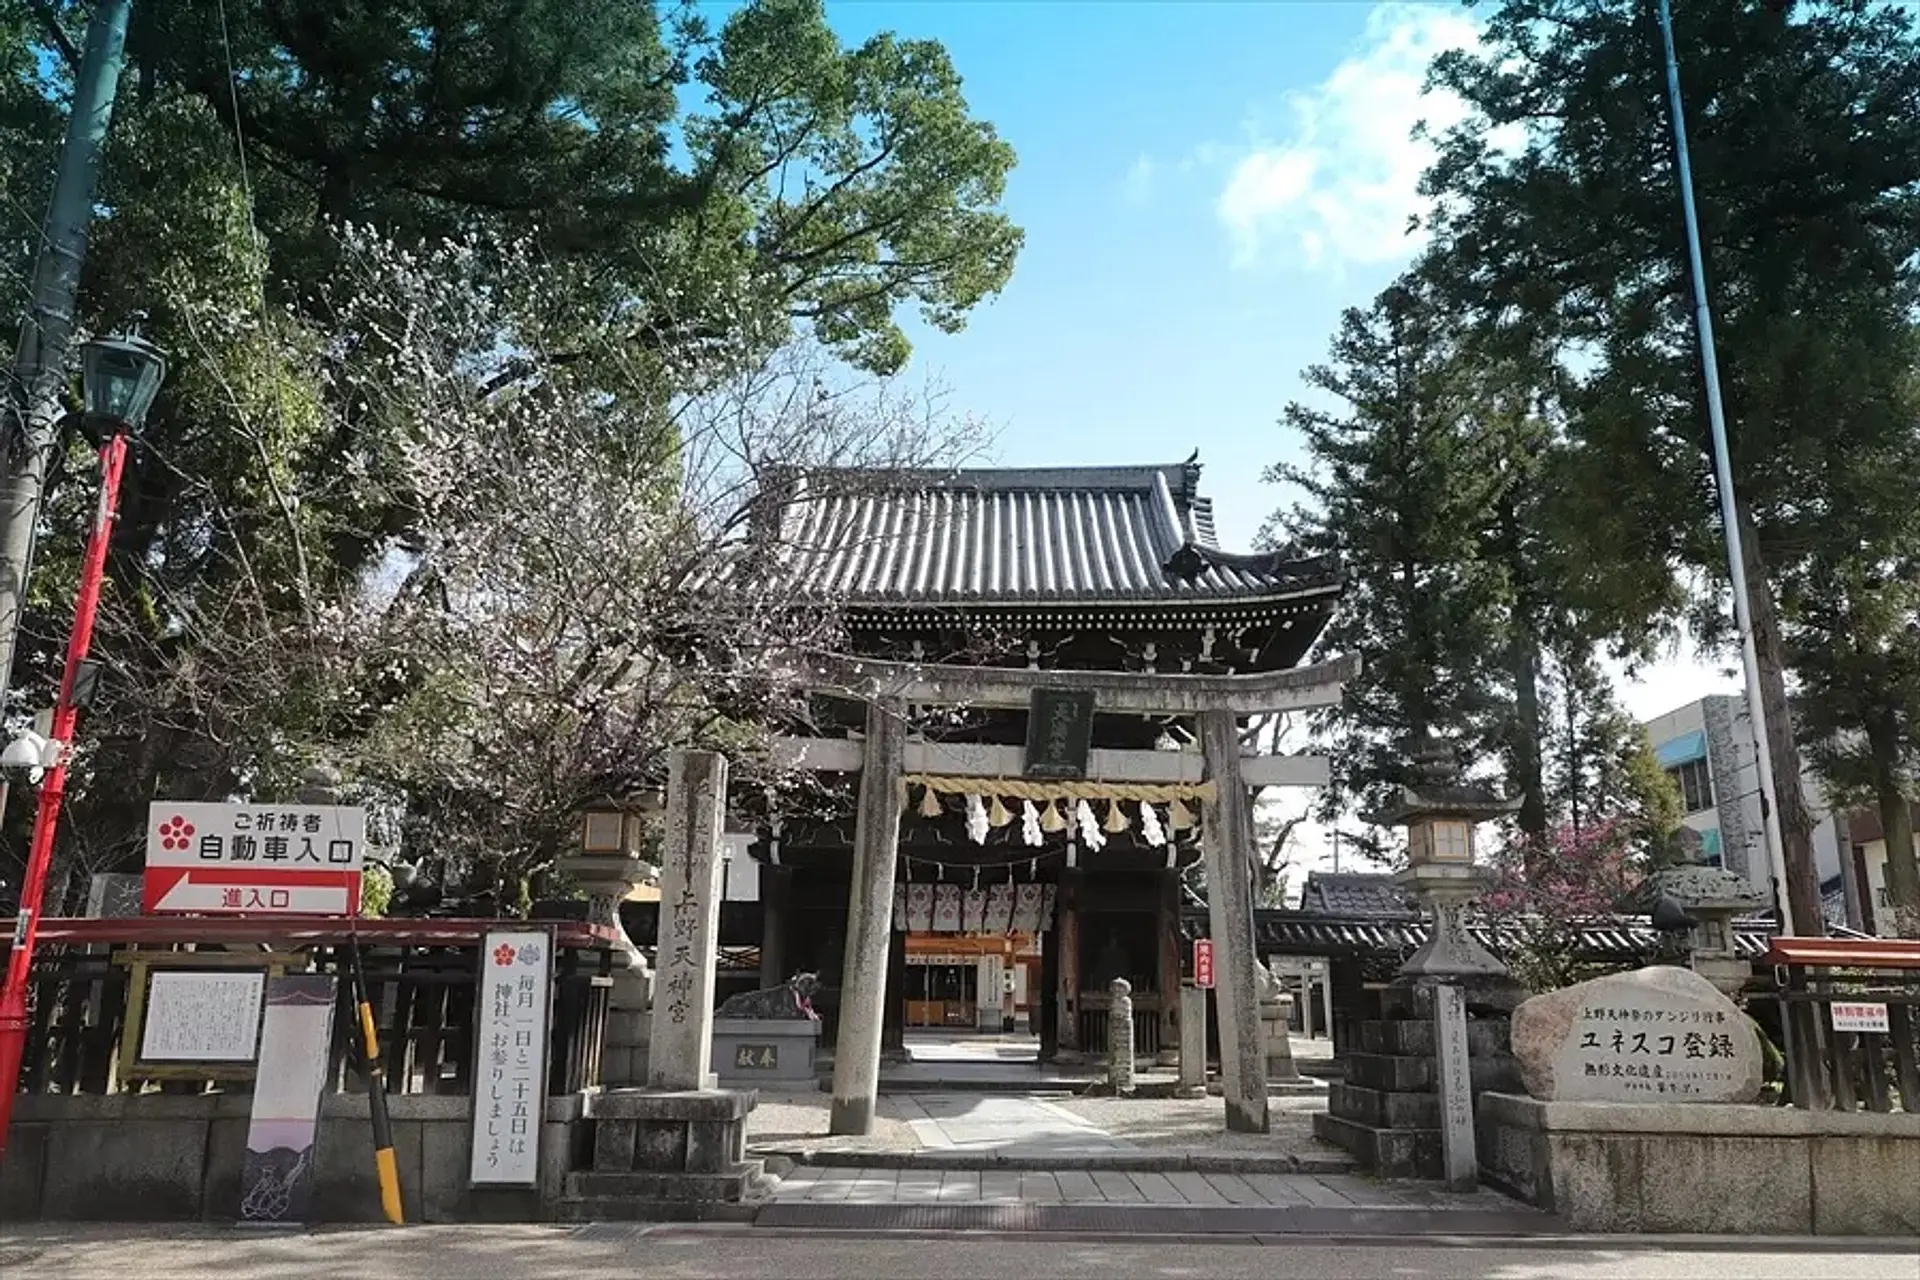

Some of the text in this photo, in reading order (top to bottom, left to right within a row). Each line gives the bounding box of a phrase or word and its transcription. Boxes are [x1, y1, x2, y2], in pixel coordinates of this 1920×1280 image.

[234, 812, 322, 833] ご祈祷者
[199, 834, 353, 863] 自動車入口
[222, 888, 289, 908] 進入口
[667, 890, 699, 1023] 上野天神宮
[1580, 1028, 1735, 1059] ユネスコ登録
[509, 974, 535, 1155] 毎月一日と二十五日は
[1584, 1062, 1664, 1078] 無形文化遺産
